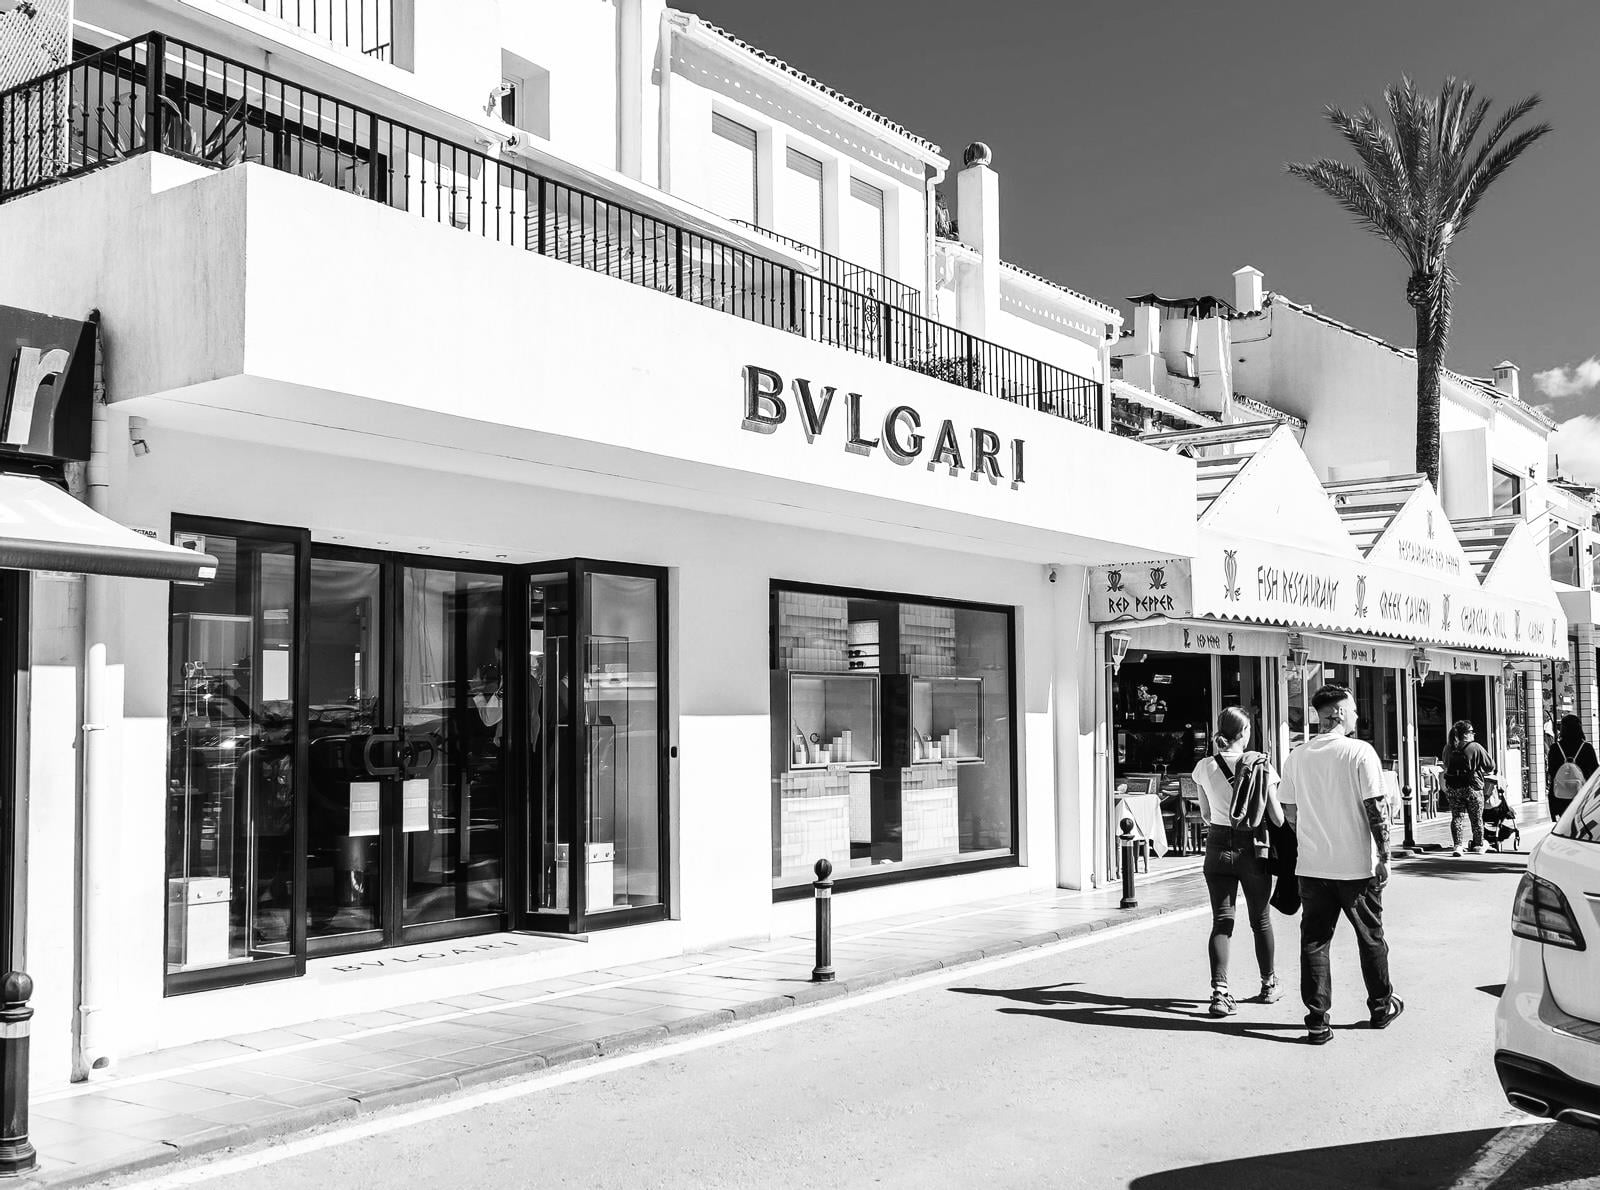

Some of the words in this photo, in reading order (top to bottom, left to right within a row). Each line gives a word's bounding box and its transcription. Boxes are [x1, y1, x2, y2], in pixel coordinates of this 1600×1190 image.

[6, 346, 70, 445] r
[741, 365, 1025, 489] BVLGARI
[1108, 597, 1130, 613] RED
[1135, 594, 1174, 613] PEPPER
[1257, 565, 1279, 601] FISH
[1282, 567, 1339, 613] RESTAURANT
[1379, 591, 1402, 622] GREEK
[1405, 595, 1431, 628] TAVERN
[1460, 606, 1491, 636] CHARCOAL
